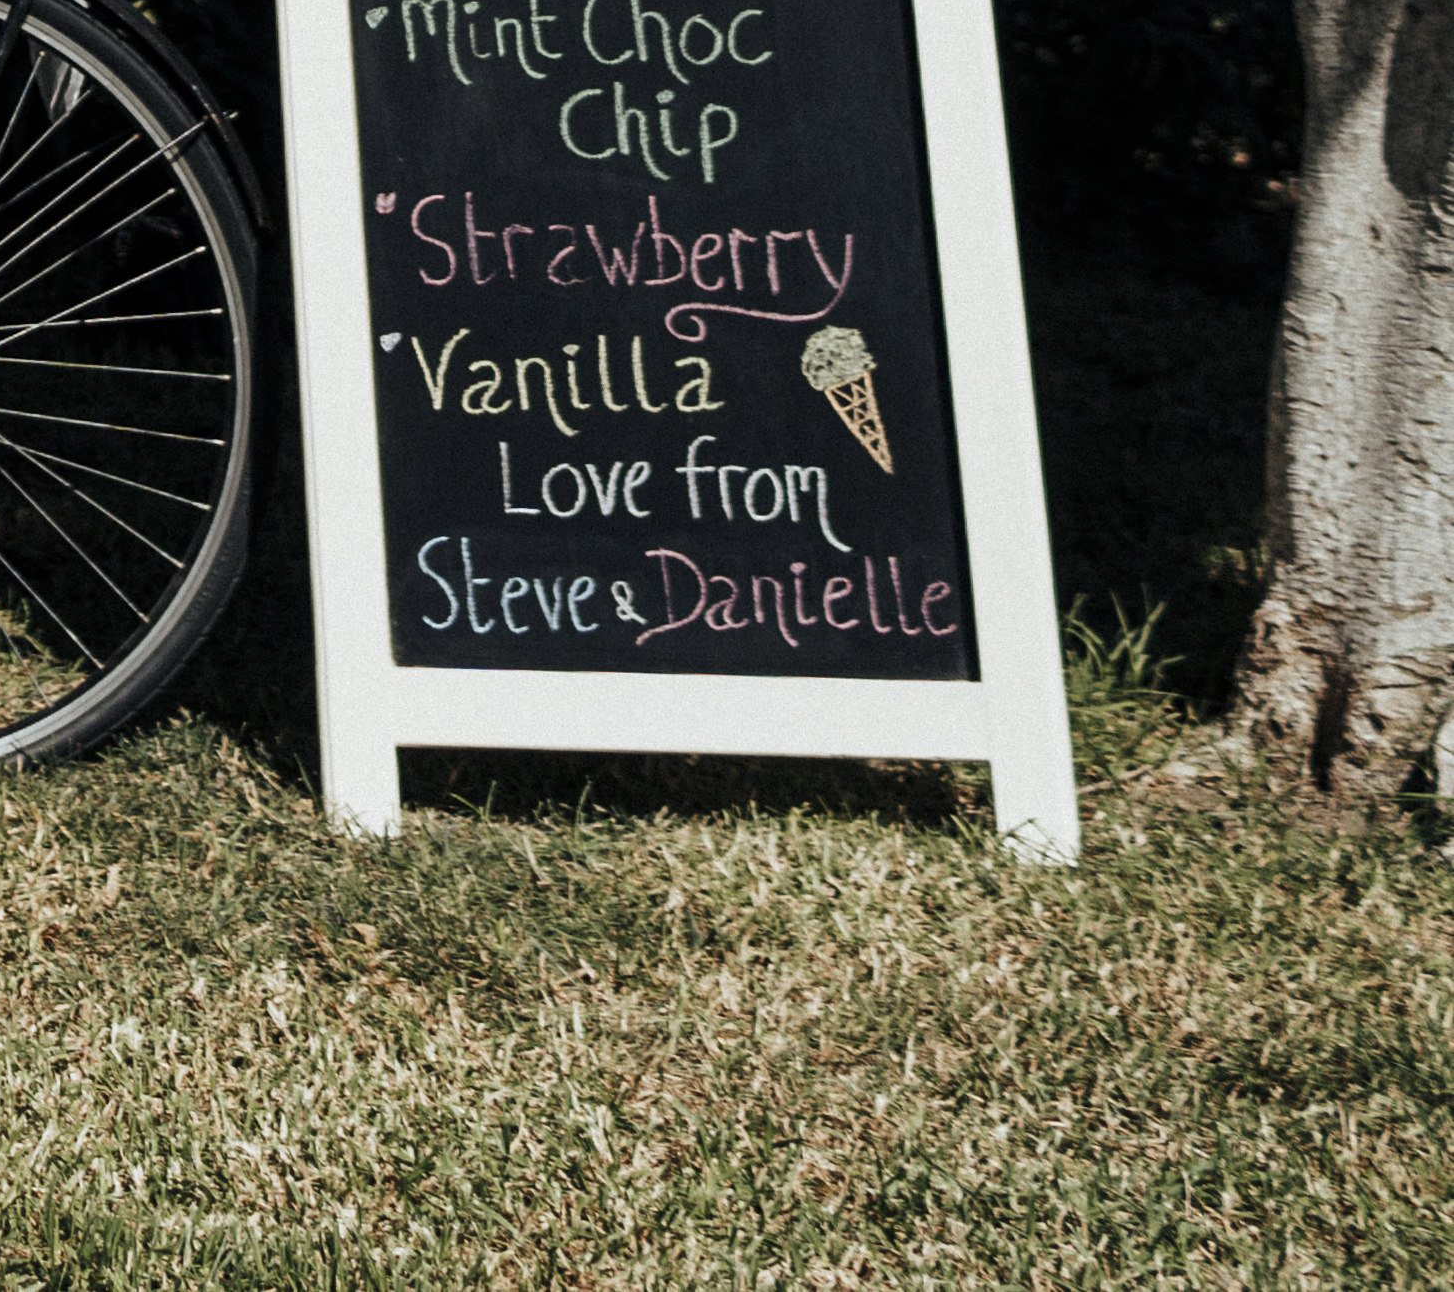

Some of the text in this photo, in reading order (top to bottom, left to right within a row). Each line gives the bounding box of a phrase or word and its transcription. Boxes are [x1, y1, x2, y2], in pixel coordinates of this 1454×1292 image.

[558, 81, 739, 183] Chip
[410, 191, 854, 342] Strawberry
[410, 329, 726, 436] Vanilla
[499, 435, 853, 552] Love from
